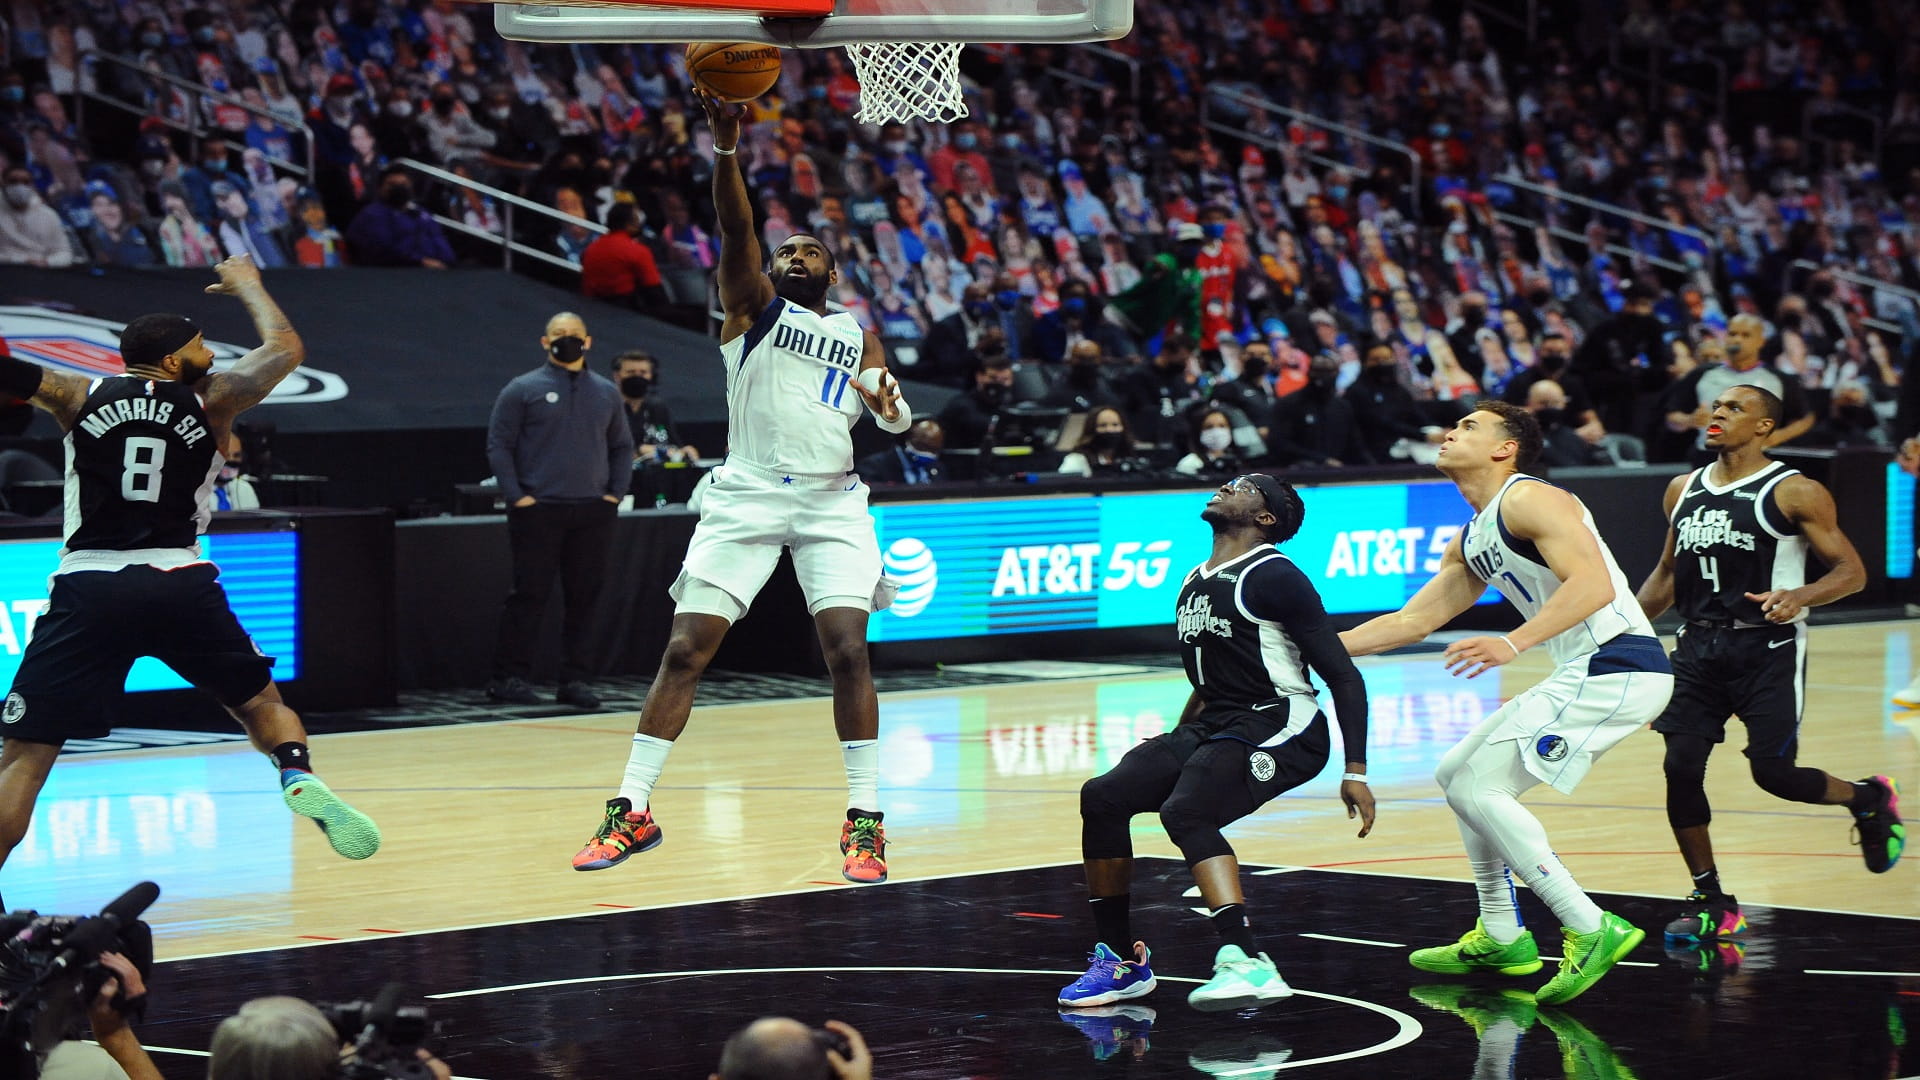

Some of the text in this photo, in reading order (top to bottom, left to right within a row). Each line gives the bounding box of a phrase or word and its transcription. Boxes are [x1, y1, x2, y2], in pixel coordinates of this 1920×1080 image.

[724, 46, 780, 64] PALDING
[774, 324, 858, 368] DALLAS
[821, 366, 851, 408] 11
[79, 398, 207, 449] MORRIS SR.
[121, 436, 167, 503] 8
[1691, 505, 1728, 527] Los
[1325, 525, 1463, 578] AT&T 5
[1674, 517, 1755, 557] Angeles
[991, 540, 1172, 597] AT&T 5G
[1698, 556, 1720, 592] 4
[1185, 591, 1209, 614] Los
[0, 598, 49, 655] AT
[1177, 604, 1232, 643] Angeles
[1195, 647, 1205, 685] 1
